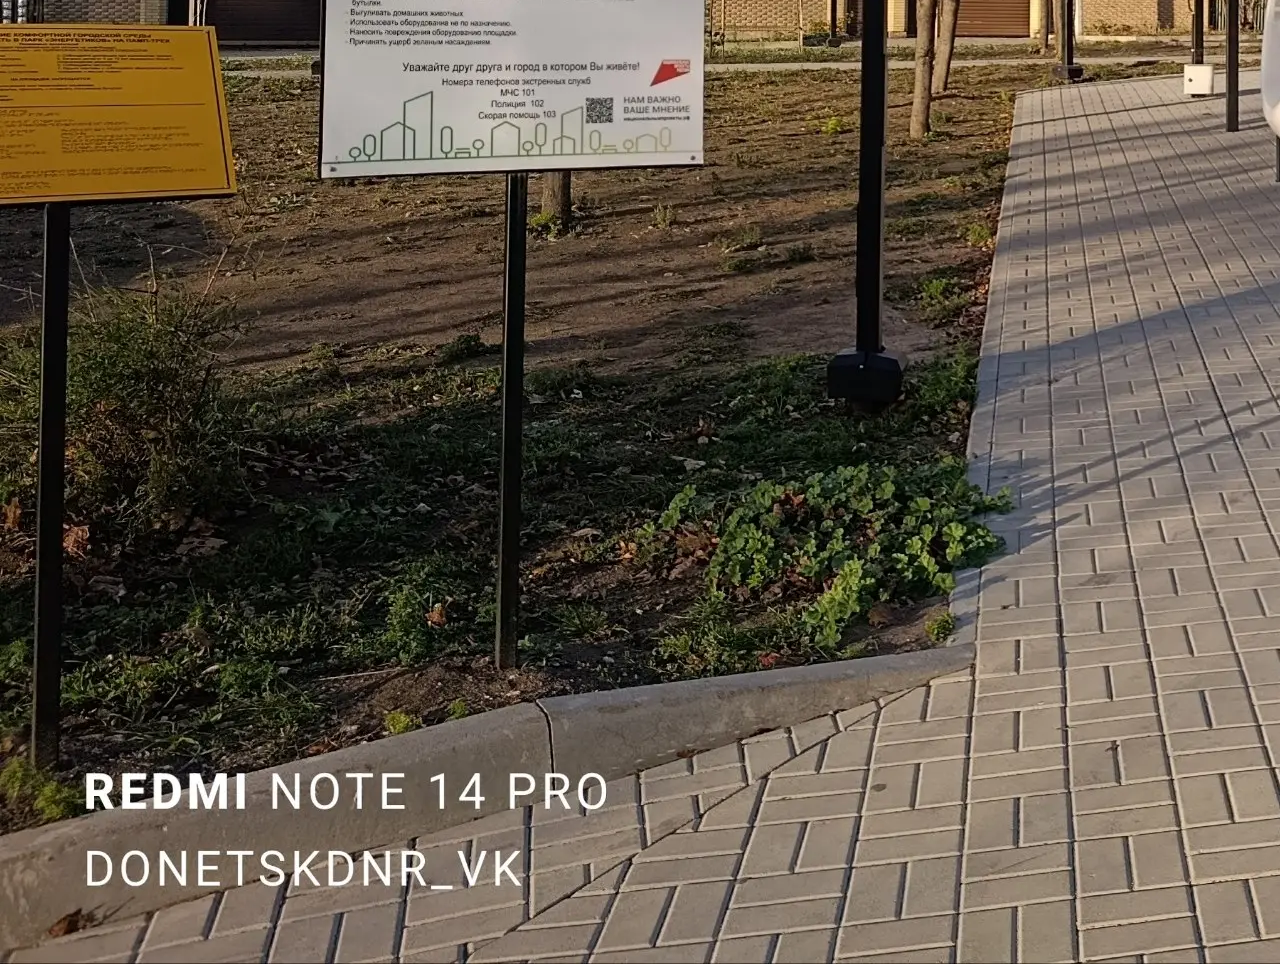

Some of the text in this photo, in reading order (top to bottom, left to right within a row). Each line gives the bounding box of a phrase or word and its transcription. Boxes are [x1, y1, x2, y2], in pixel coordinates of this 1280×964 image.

[402, 62, 449, 71] Уважайте
[451, 64, 473, 73] друг
[475, 63, 502, 73] друга
[513, 63, 540, 73] город
[542, 63, 547, 71] в
[550, 63, 587, 72] котором
[589, 61, 603, 70] Вы
[605, 61, 639, 70] живёте!
[441, 77, 591, 87] Номера телефонов экстренных служб
[500, 88, 534, 96] МЧС 101
[490, 99, 544, 108] Полиция 102
[646, 95, 680, 103] ВАЖНО
[623, 105, 689, 114] ВАШЕ МНЕНИЕ
[477, 110, 556, 120] Скорая помощь 103
